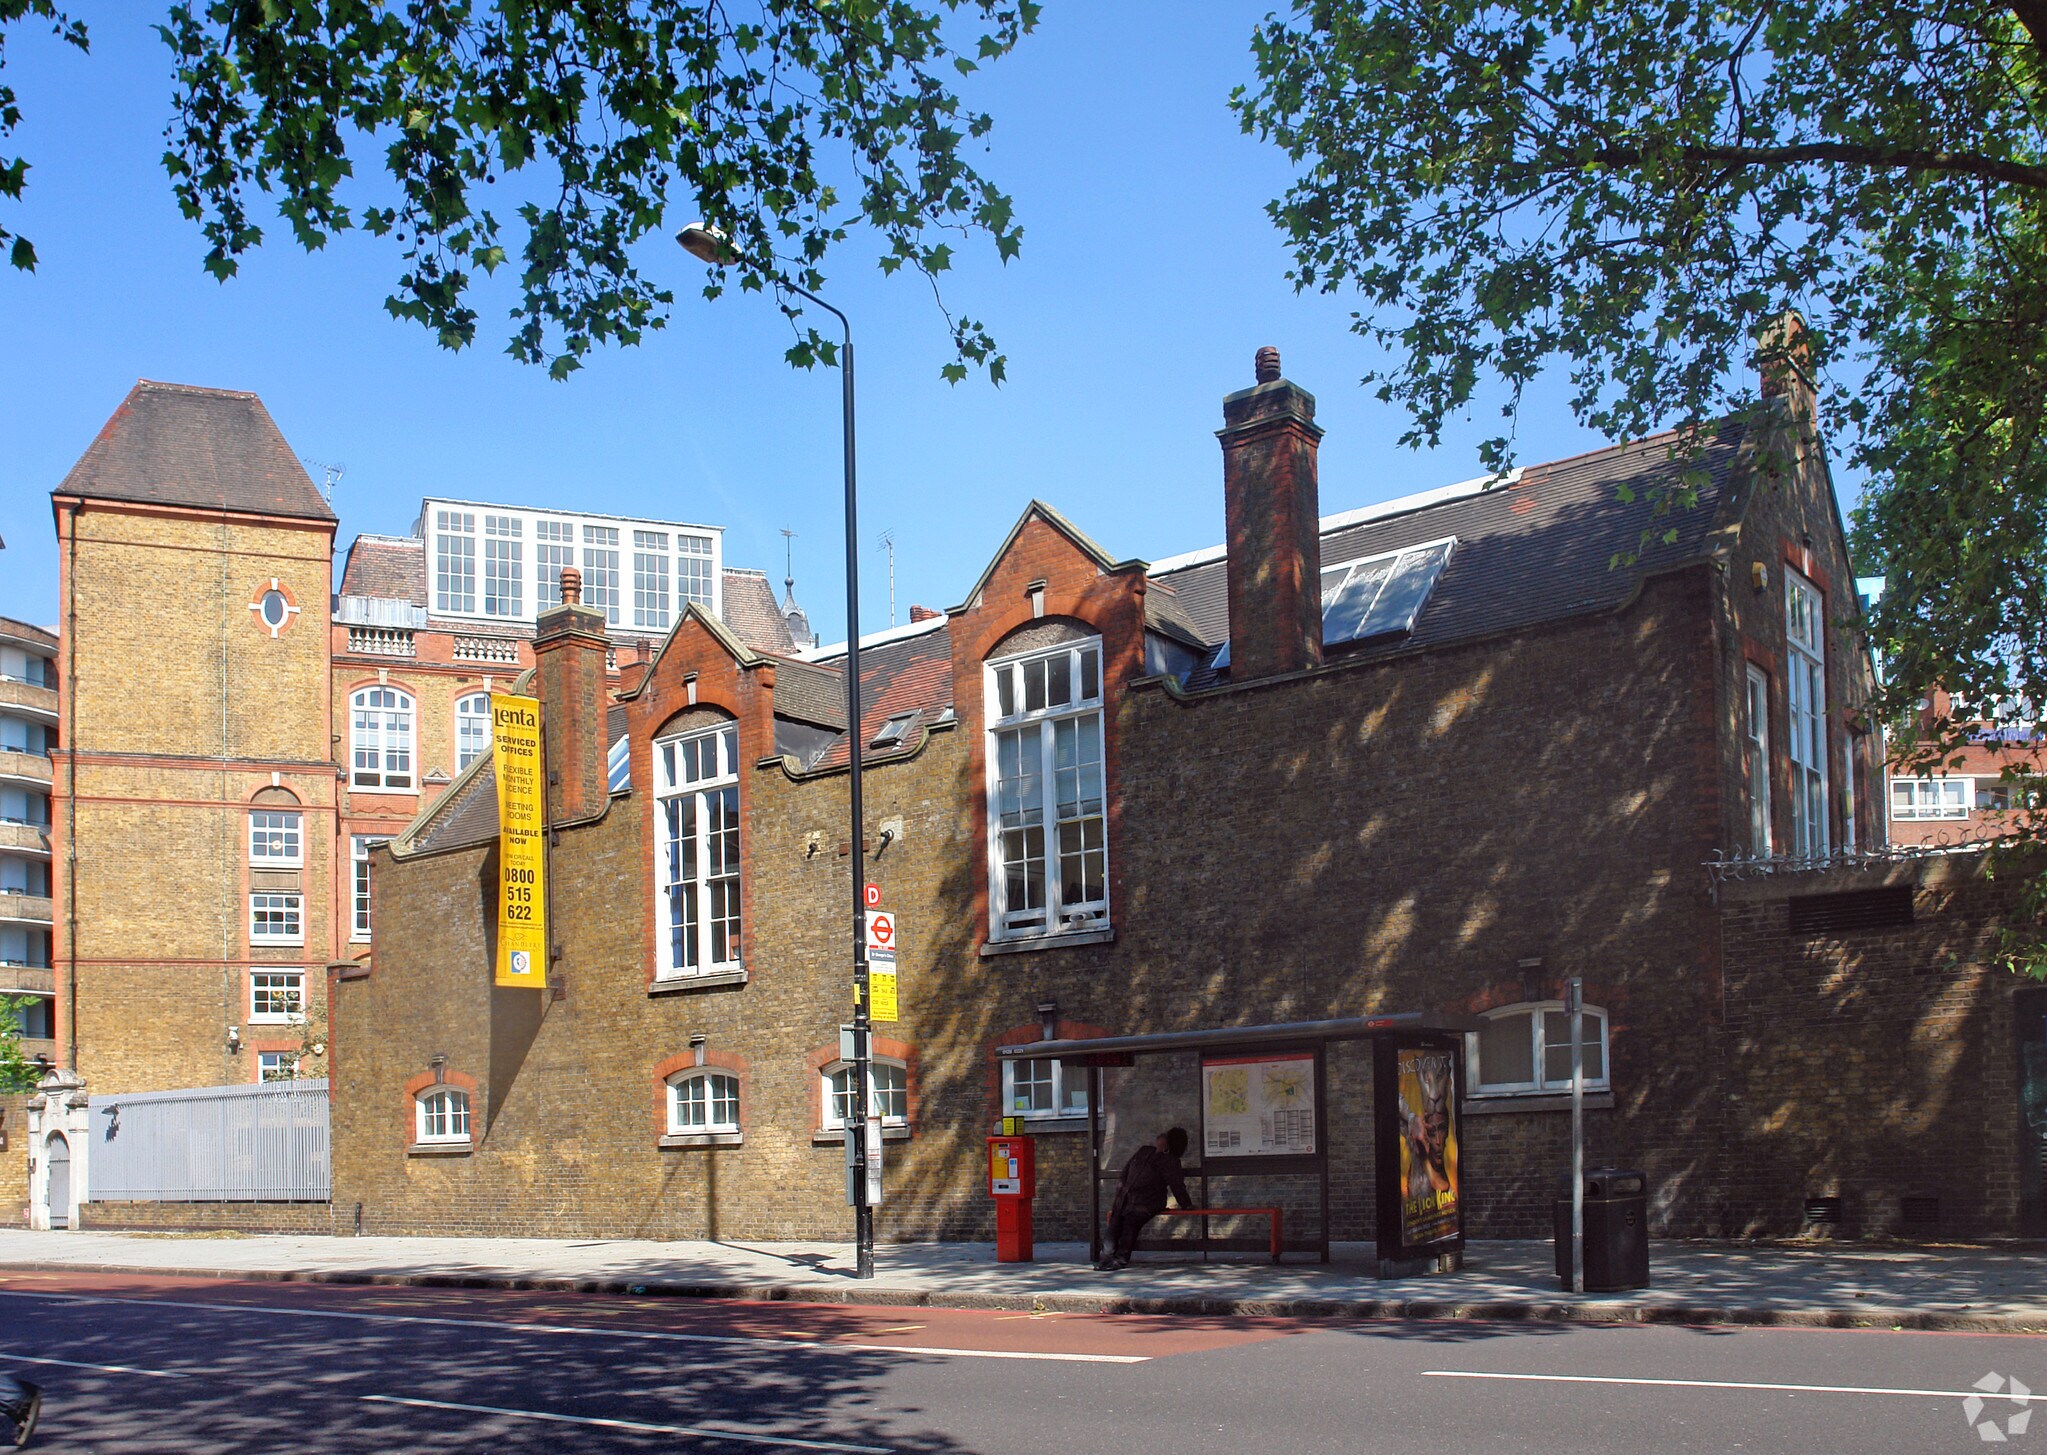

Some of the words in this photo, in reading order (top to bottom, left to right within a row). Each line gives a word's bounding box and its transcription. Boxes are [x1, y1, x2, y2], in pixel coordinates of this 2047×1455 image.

[494, 708, 536, 728] Lenta
[496, 735, 536, 747] SERVICED
[501, 745, 533, 757] OFFICES
[503, 764, 533, 776] FLEXIBLE
[502, 774, 534, 785] MONTHLY
[505, 784, 533, 794] LICENCE
[503, 826, 539, 837] AVAILABLE
[509, 837, 527, 845] NOW
[505, 867, 535, 884] 0800
[507, 886, 531, 902] 515
[868, 887, 879, 904] D
[507, 904, 532, 920] 622
[1405, 1200, 1417, 1216] THE
[1417, 1195, 1436, 1216] LION
[1435, 1189, 1456, 1210] KING
